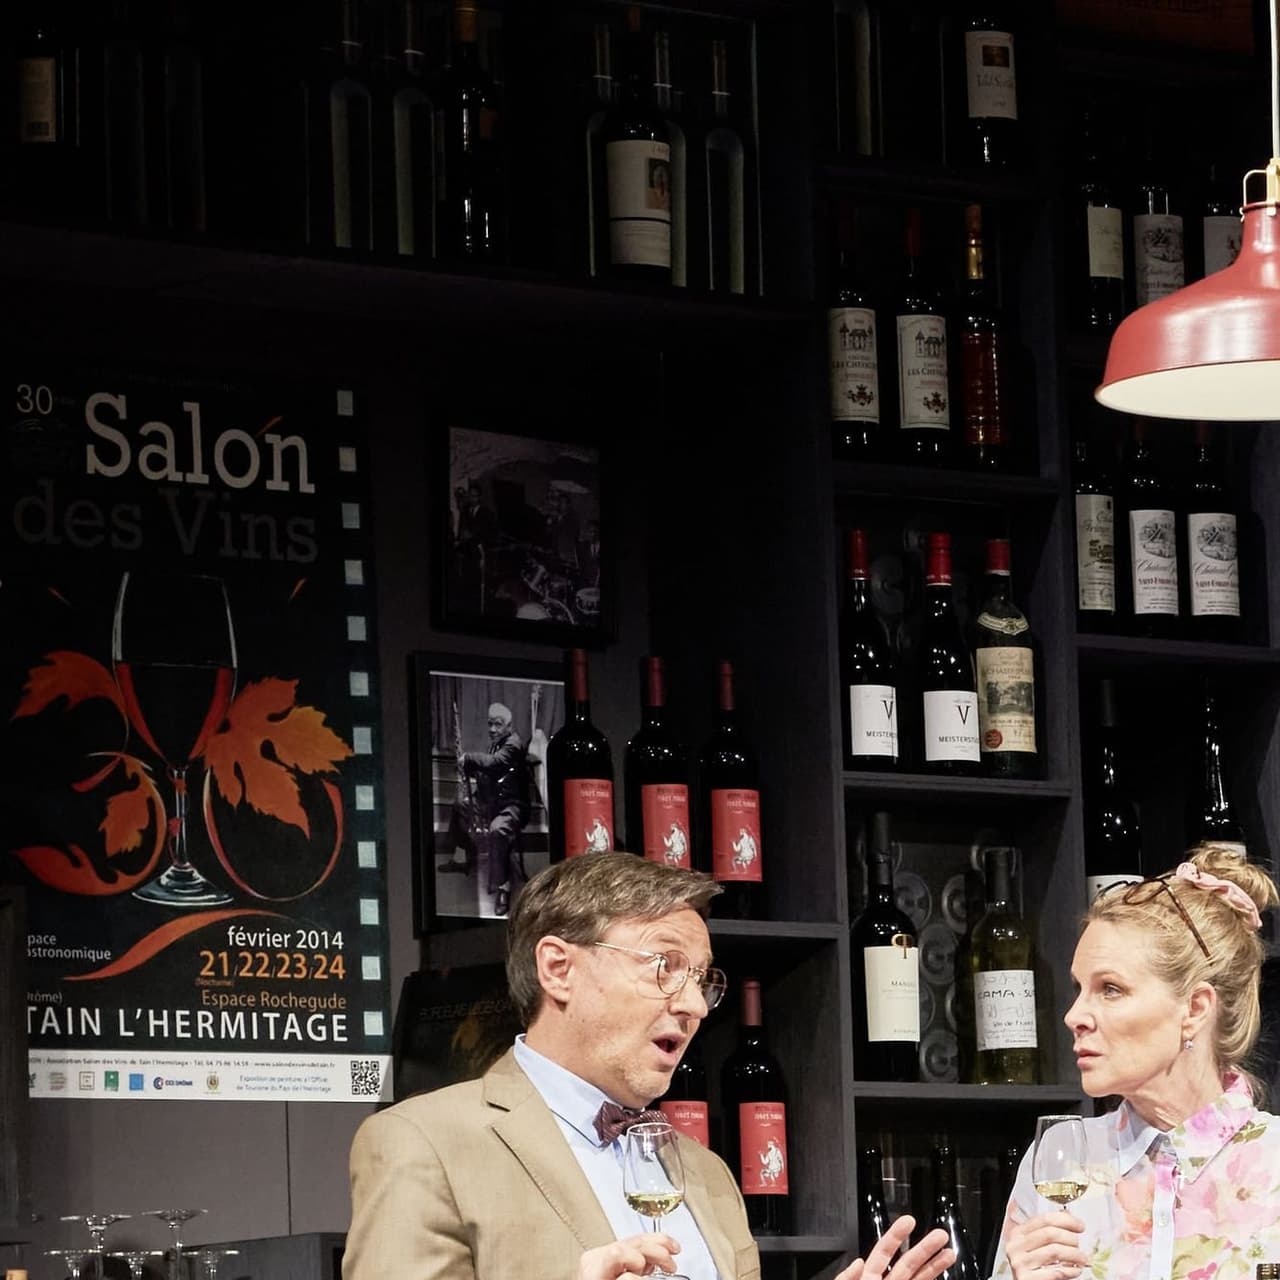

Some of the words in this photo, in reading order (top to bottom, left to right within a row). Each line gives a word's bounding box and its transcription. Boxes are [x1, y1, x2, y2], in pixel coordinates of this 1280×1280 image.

[16, 384, 53, 414] 30
[85, 392, 315, 494] Salon
[13, 479, 144, 550] des
[157, 485, 319, 563] Vins
[883, 700, 894, 720] V
[957, 705, 971, 725] V
[866, 731, 897, 739] MEISTER
[27, 933, 56, 947] pace
[227, 926, 291, 950] février
[296, 931, 344, 950] 2014
[201, 989, 256, 1012] Espace
[260, 991, 347, 1013] Rochegude
[27, 1006, 101, 1037] TAIN
[118, 1009, 348, 1042] L'HERMITAGE
